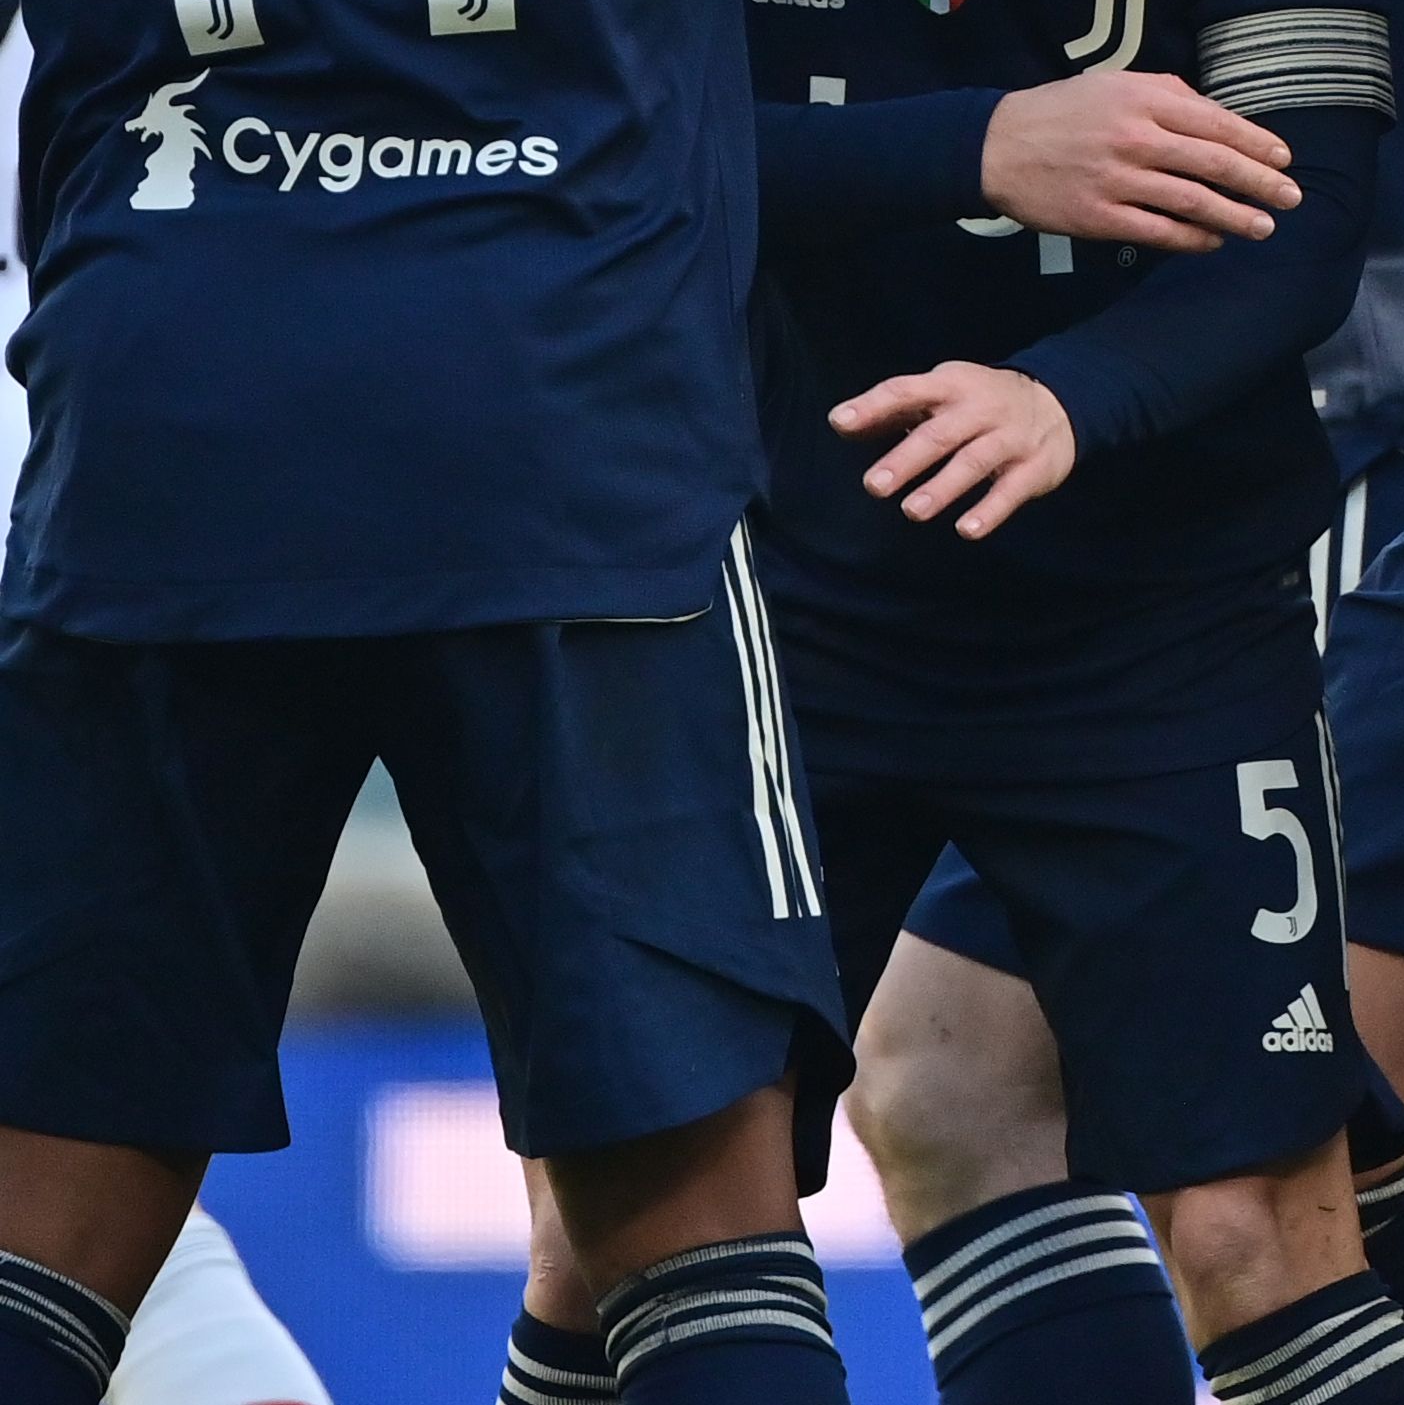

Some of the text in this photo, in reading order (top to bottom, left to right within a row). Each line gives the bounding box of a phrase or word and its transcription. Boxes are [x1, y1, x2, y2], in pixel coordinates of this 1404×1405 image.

[222, 117, 560, 193] Cygames
[1236, 759, 1318, 944] 5
[1262, 1024, 1334, 1053] adidas
